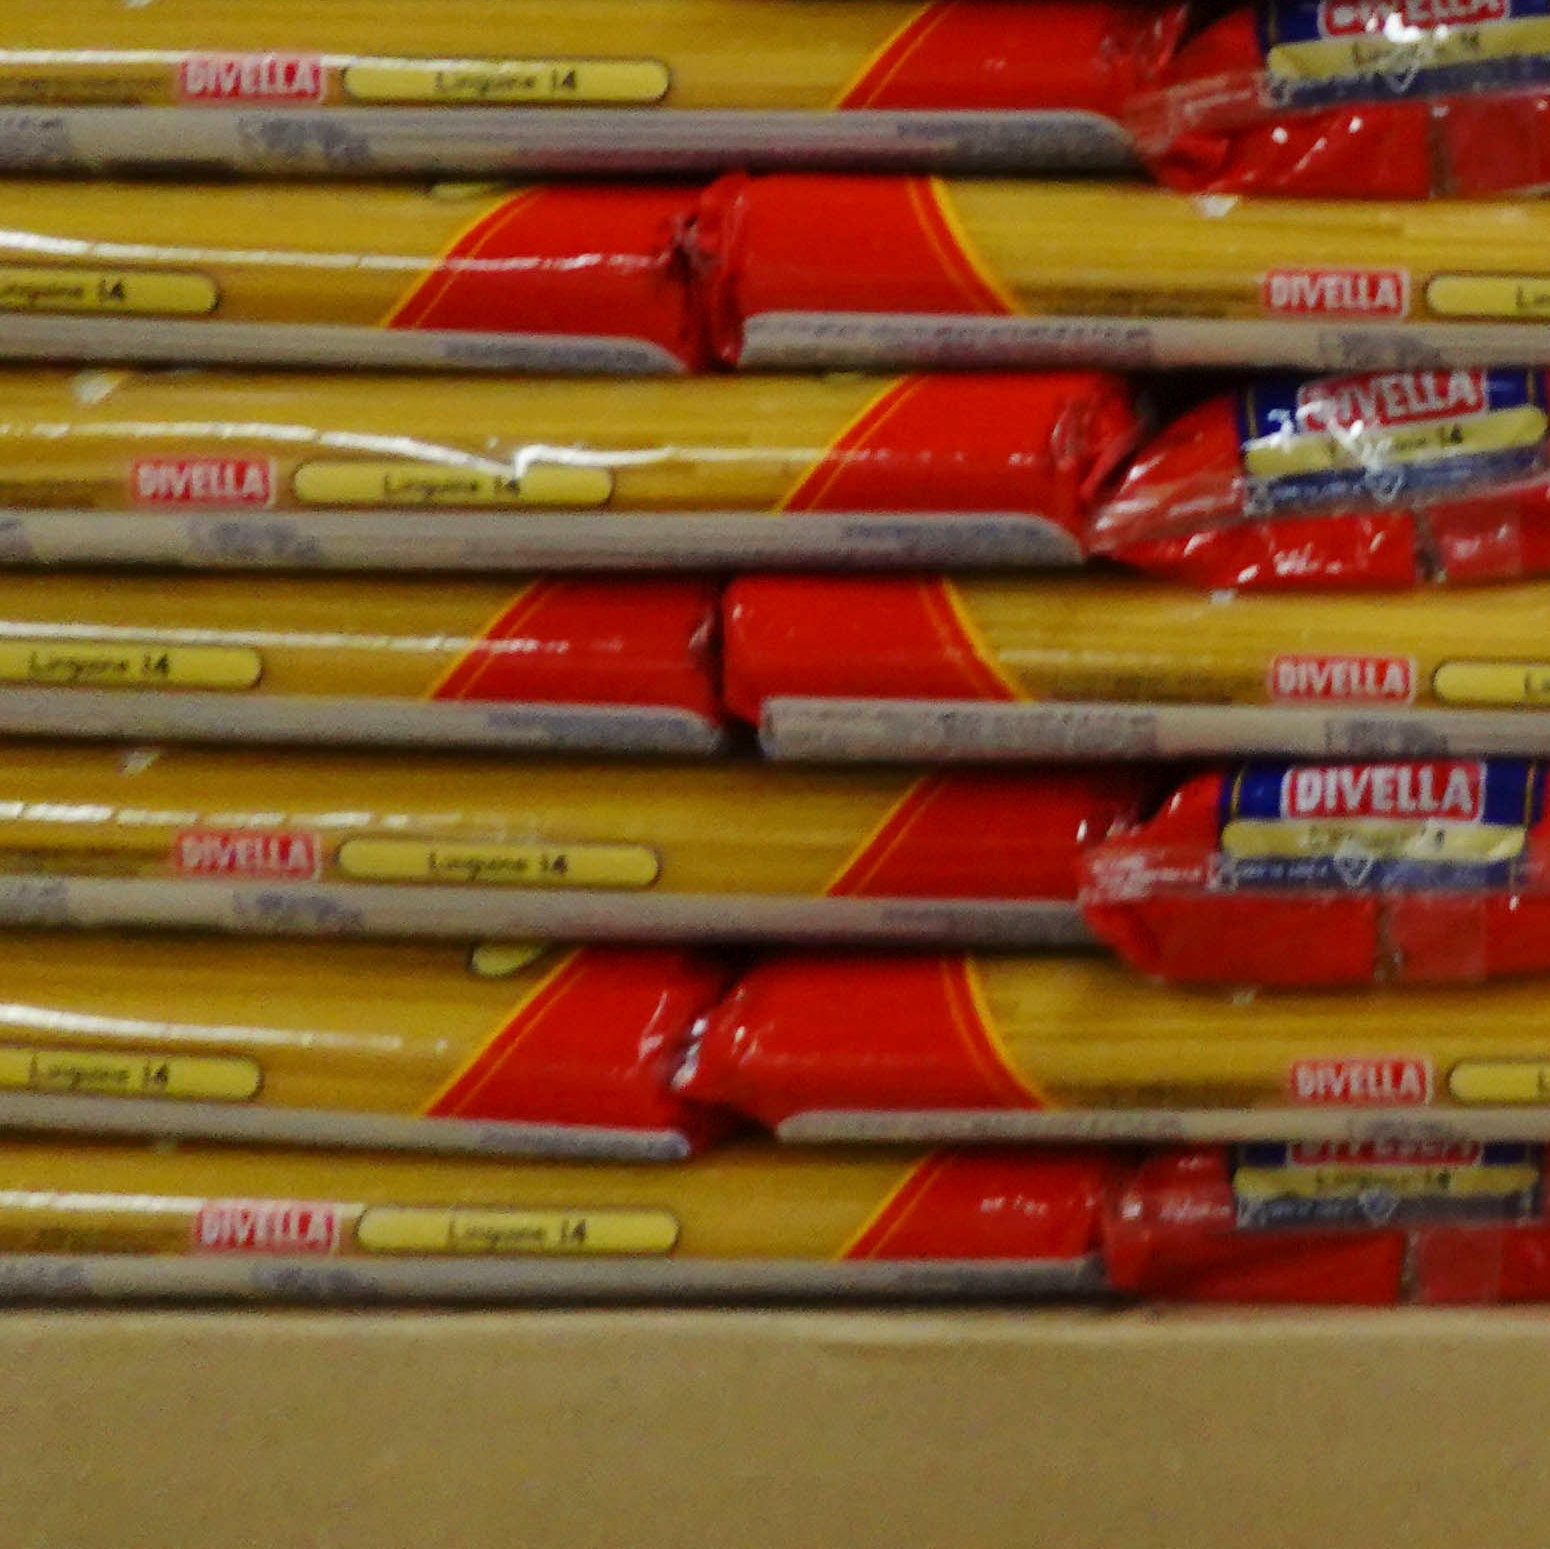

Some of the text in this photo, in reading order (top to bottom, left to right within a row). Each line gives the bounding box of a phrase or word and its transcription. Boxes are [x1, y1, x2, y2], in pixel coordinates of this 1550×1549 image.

[183, 58, 322, 98] DIVELLA
[549, 69, 576, 91] 14
[1269, 272, 1400, 311] DIVELLA
[138, 461, 270, 503] DIVELLA
[1271, 658, 1405, 698] DIVELLA
[1295, 765, 1472, 815] DIVELLA
[180, 832, 314, 872] DIVELLA
[1296, 1057, 1428, 1097] DIVELLA
